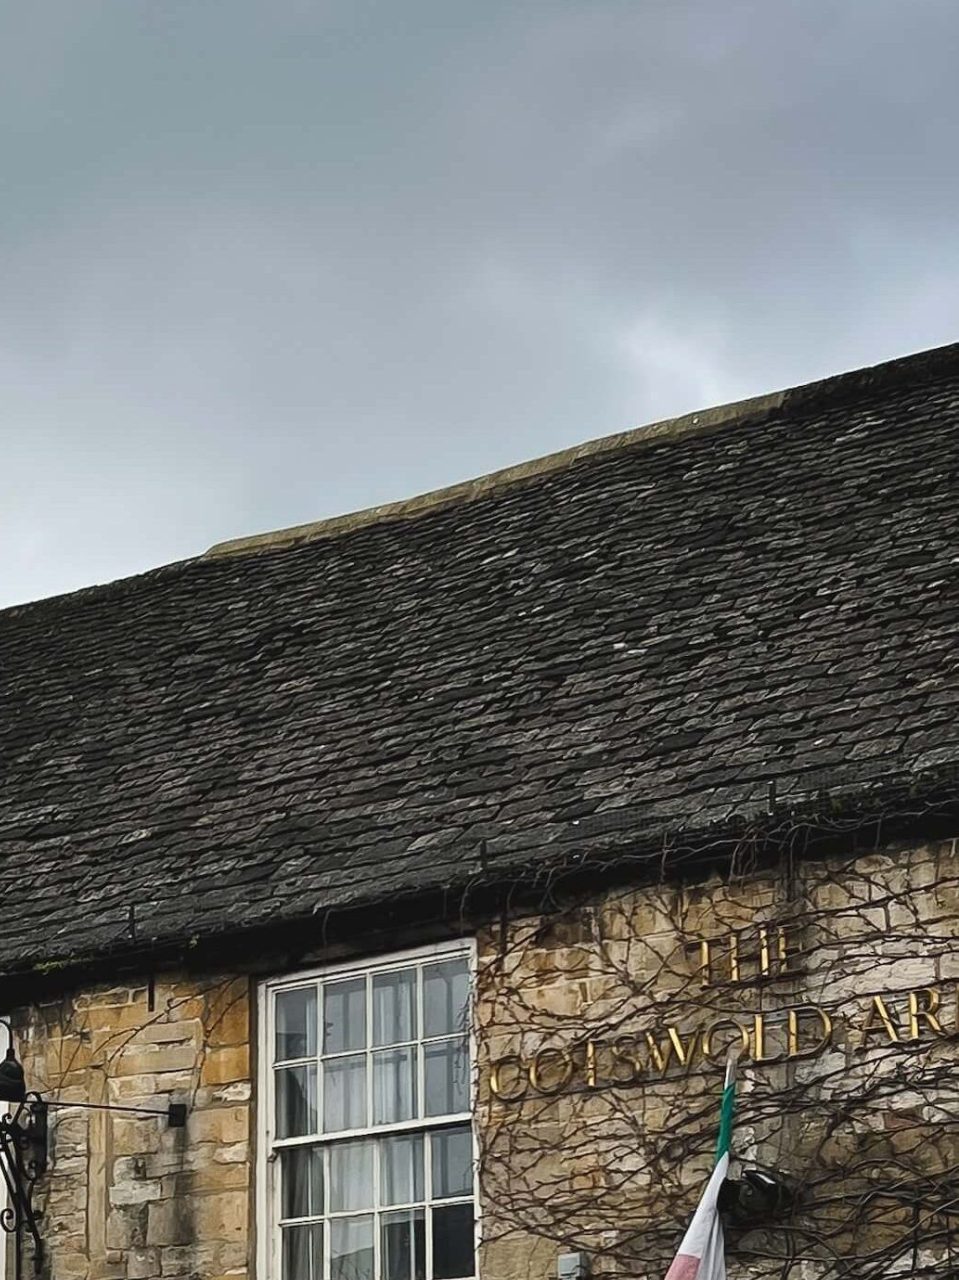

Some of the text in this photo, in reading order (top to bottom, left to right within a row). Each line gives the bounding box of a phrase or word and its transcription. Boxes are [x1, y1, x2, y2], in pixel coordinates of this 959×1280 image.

[685, 924, 804, 988] THE
[488, 982, 959, 1100] COTSWOLD AR
